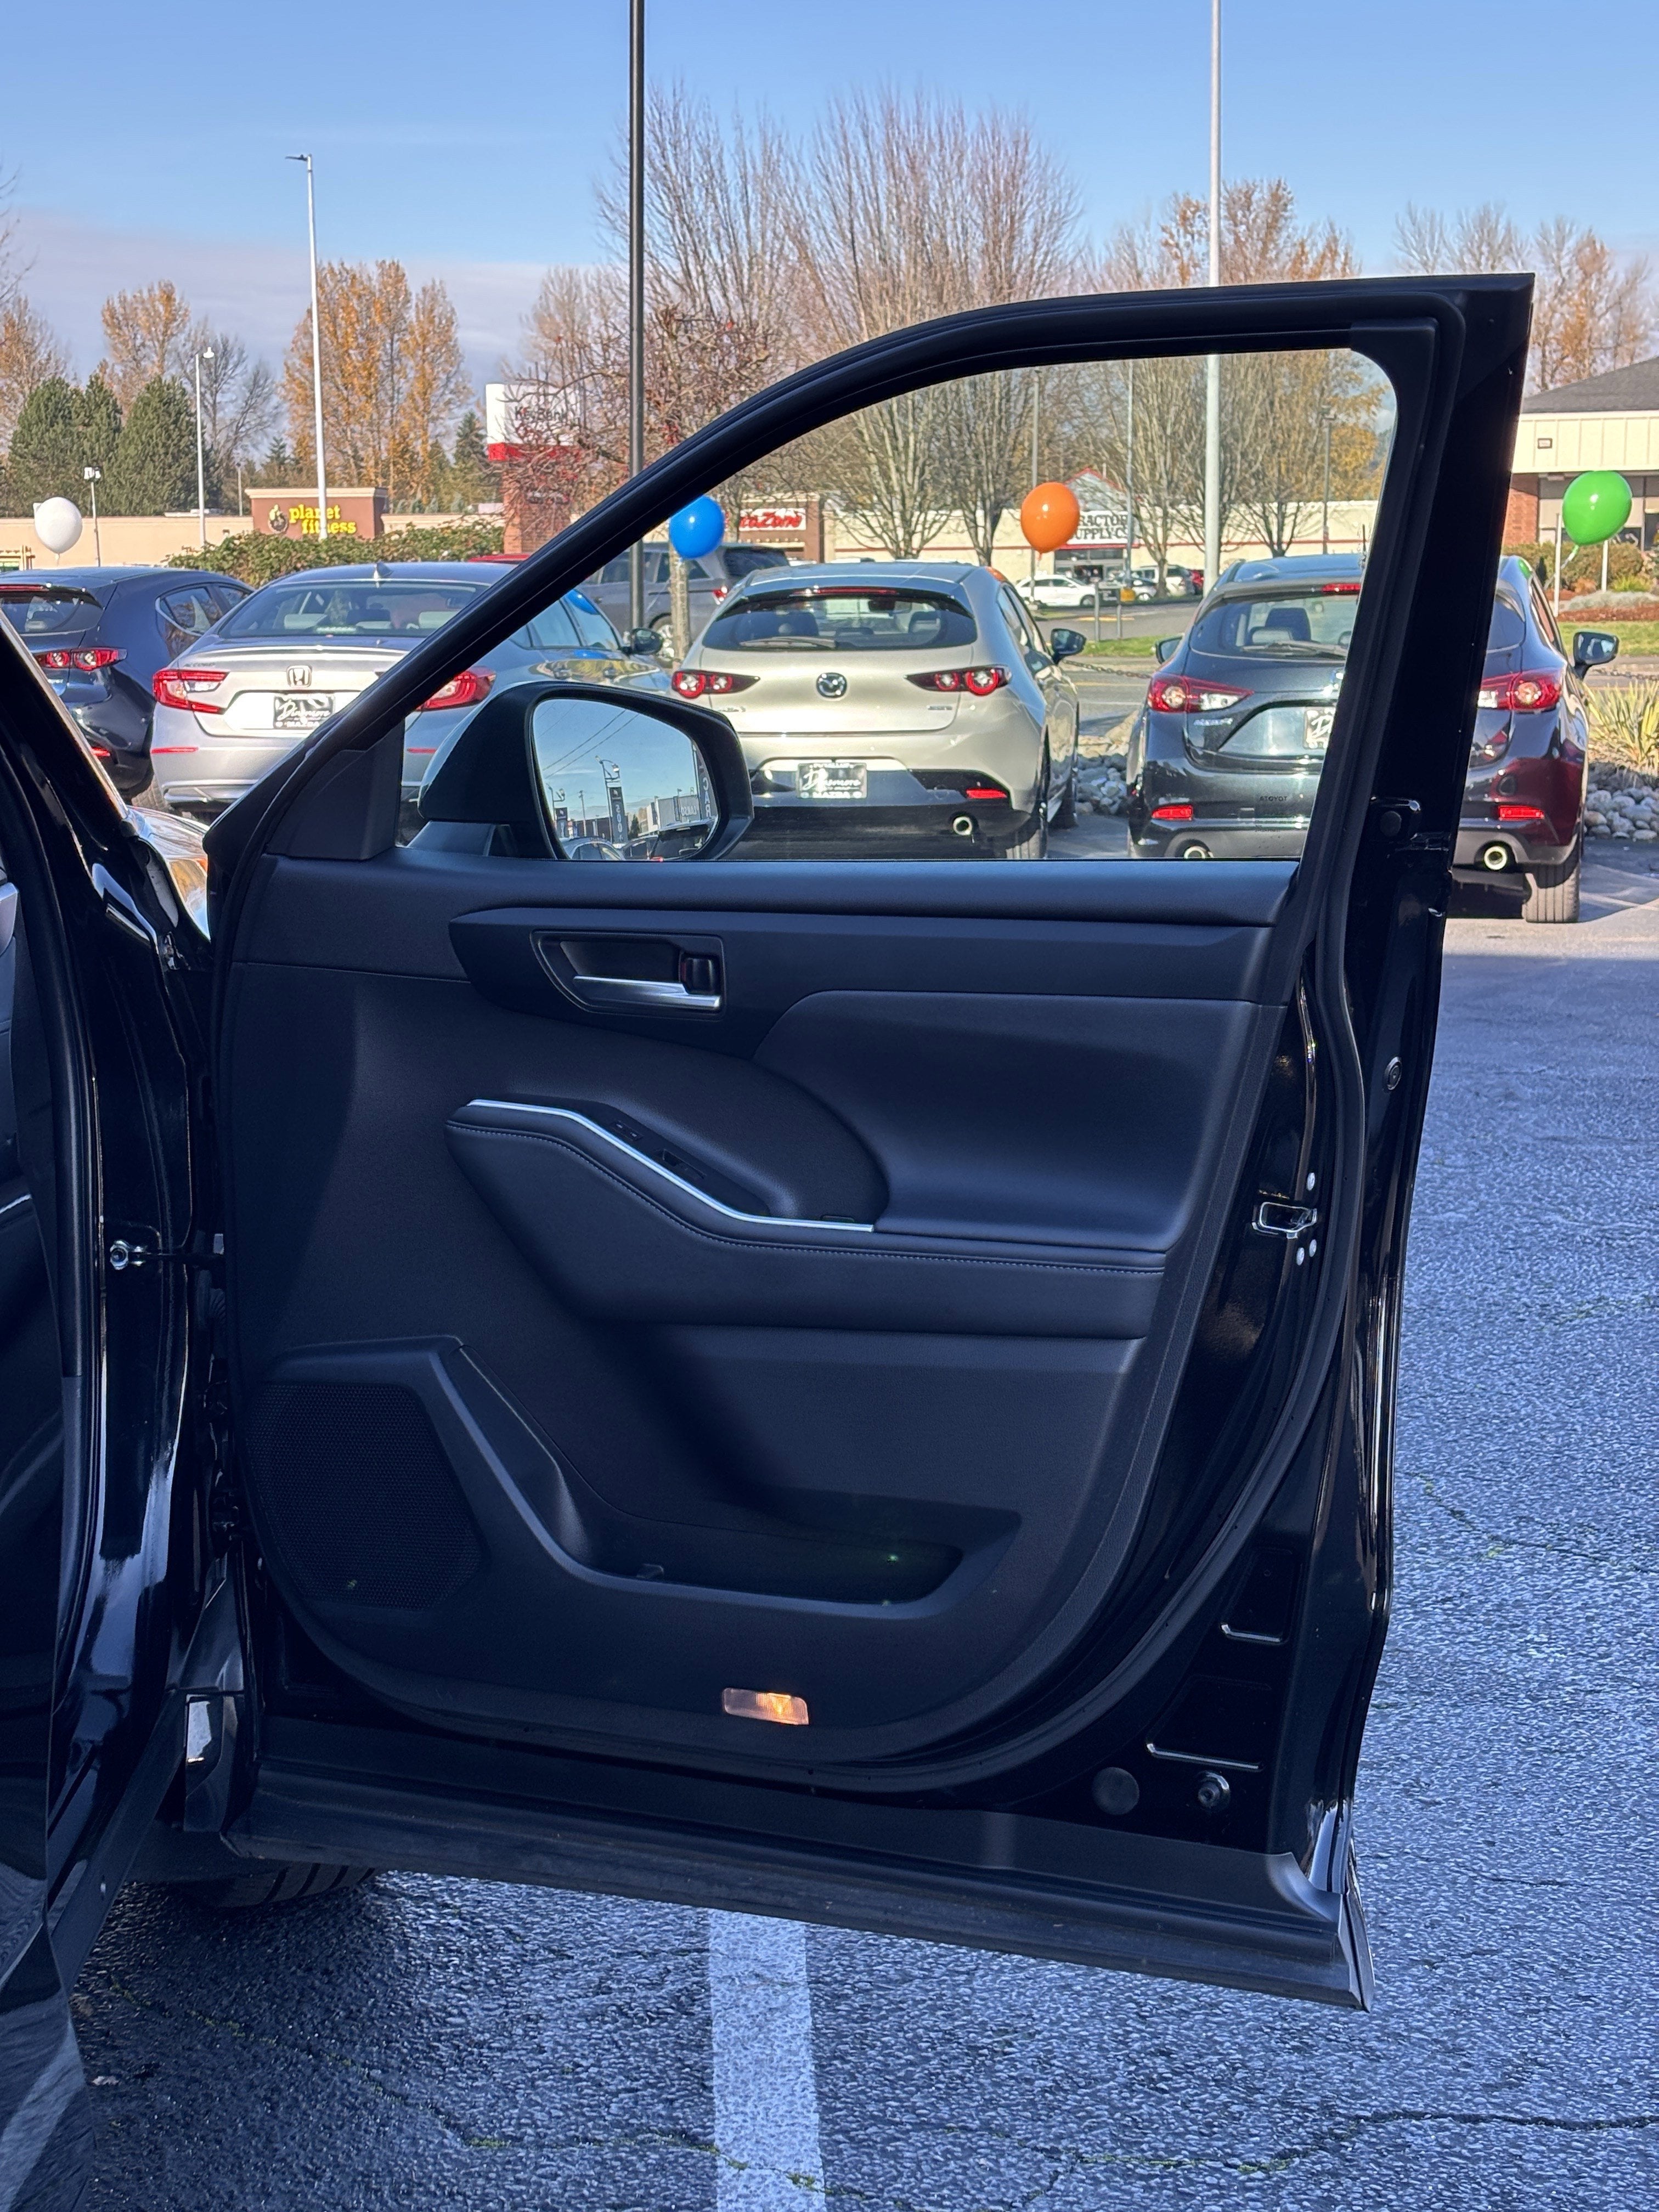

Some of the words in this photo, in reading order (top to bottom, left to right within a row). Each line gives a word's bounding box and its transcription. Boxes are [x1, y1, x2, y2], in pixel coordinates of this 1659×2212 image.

[725, 511, 802, 528] toZone
[1079, 515, 1128, 526] RACTOR
[1075, 527, 1114, 539] UPPLY
[803, 768, 861, 791] Dnsmore
